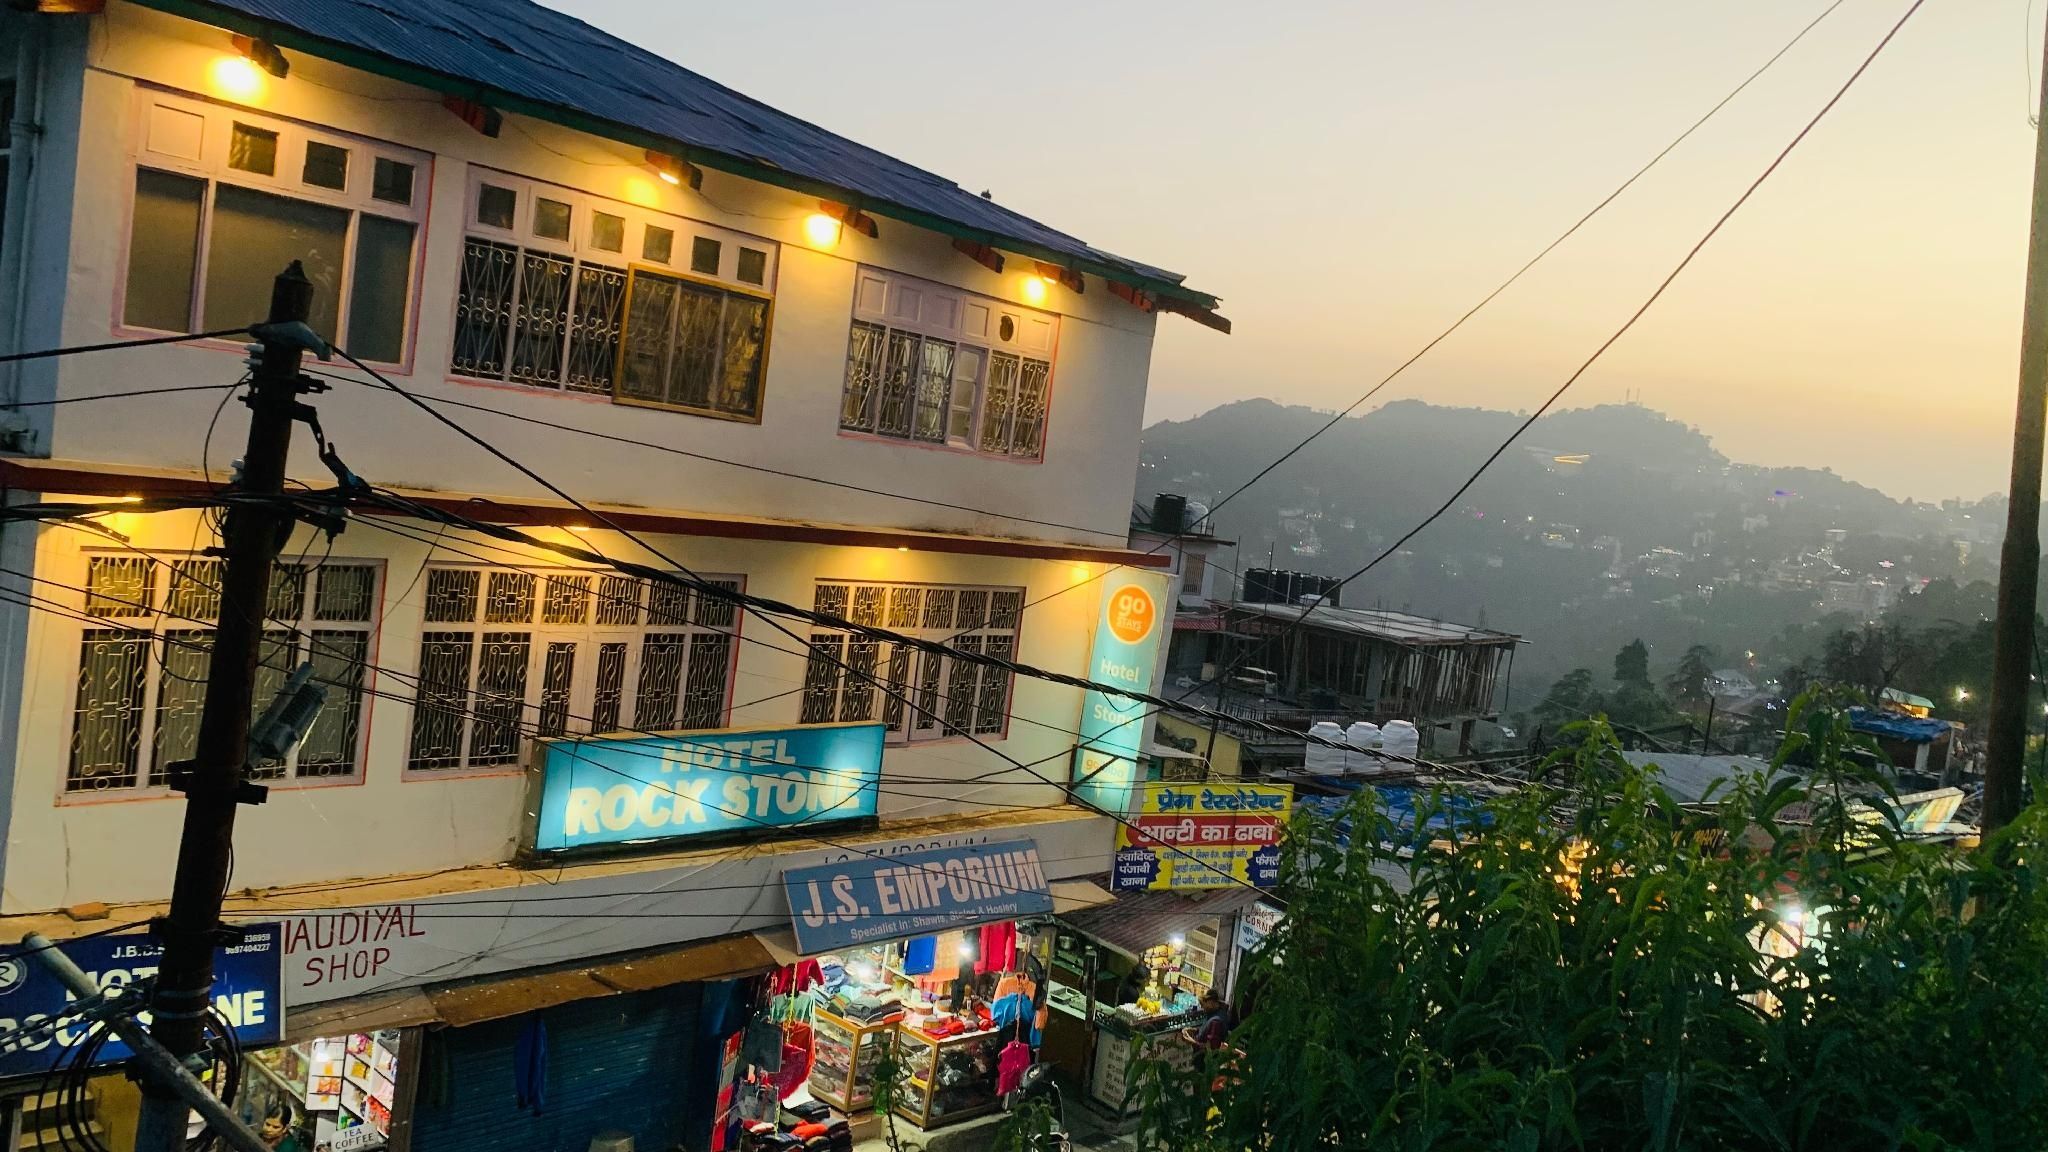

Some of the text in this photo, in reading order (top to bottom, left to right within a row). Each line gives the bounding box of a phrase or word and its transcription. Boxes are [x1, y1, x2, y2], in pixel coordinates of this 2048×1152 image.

[1118, 593, 1146, 617] go
[1116, 616, 1143, 632] STAYS
[1100, 657, 1139, 683] Hotel
[1093, 704, 1135, 729] Stone
[661, 739, 797, 773] HOTEL
[564, 769, 864, 837] ROCK STONE
[1157, 788, 1196, 812] प्रेम
[1200, 824, 1231, 841] का
[1119, 861, 1151, 874] पंजाबी
[802, 874, 871, 928] J.S.
[873, 848, 1047, 915] EMPORIUM
[850, 921, 898, 940] Specialist
[986, 902, 1019, 915] Hosiery
[302, 947, 391, 987] SHOP
[335, 1133, 374, 1150] COFFEE
[343, 1128, 362, 1139] TEA
